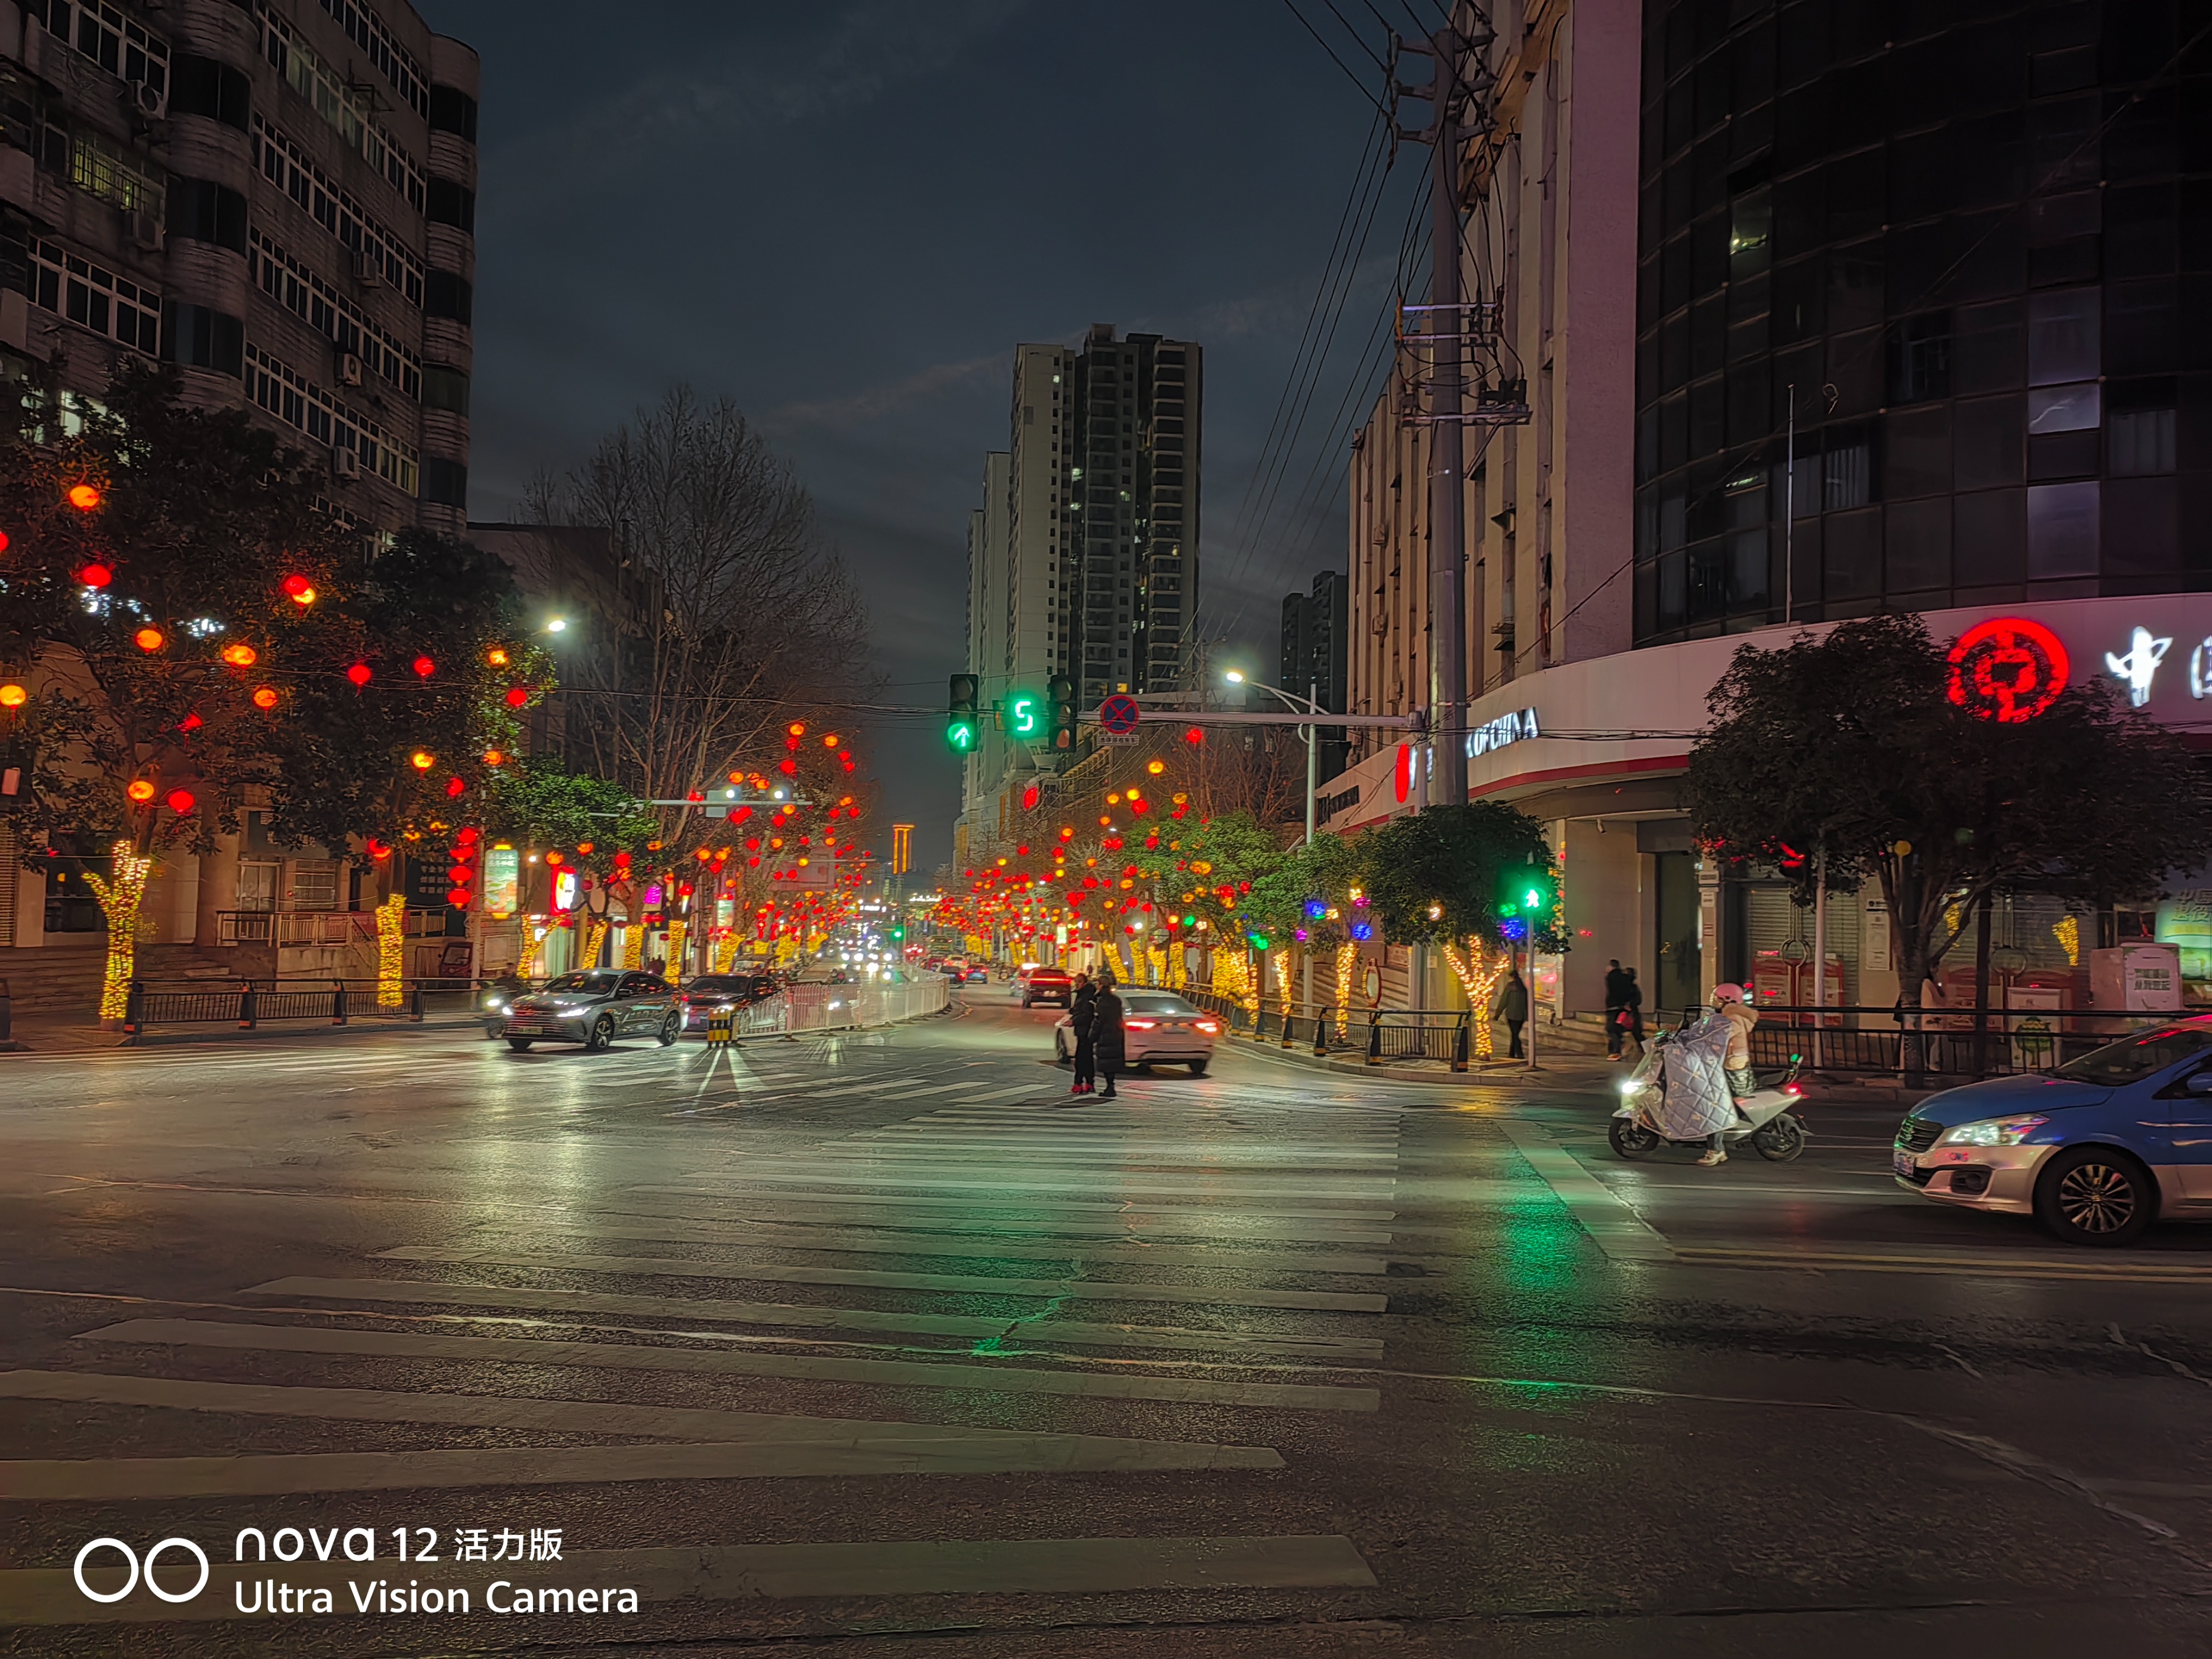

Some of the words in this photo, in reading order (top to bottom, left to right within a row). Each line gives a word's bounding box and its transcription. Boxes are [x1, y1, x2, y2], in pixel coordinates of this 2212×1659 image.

[1015, 701, 1034, 731] 5
[1474, 723, 1490, 757] OF
[1490, 706, 1539, 751] CHINA
